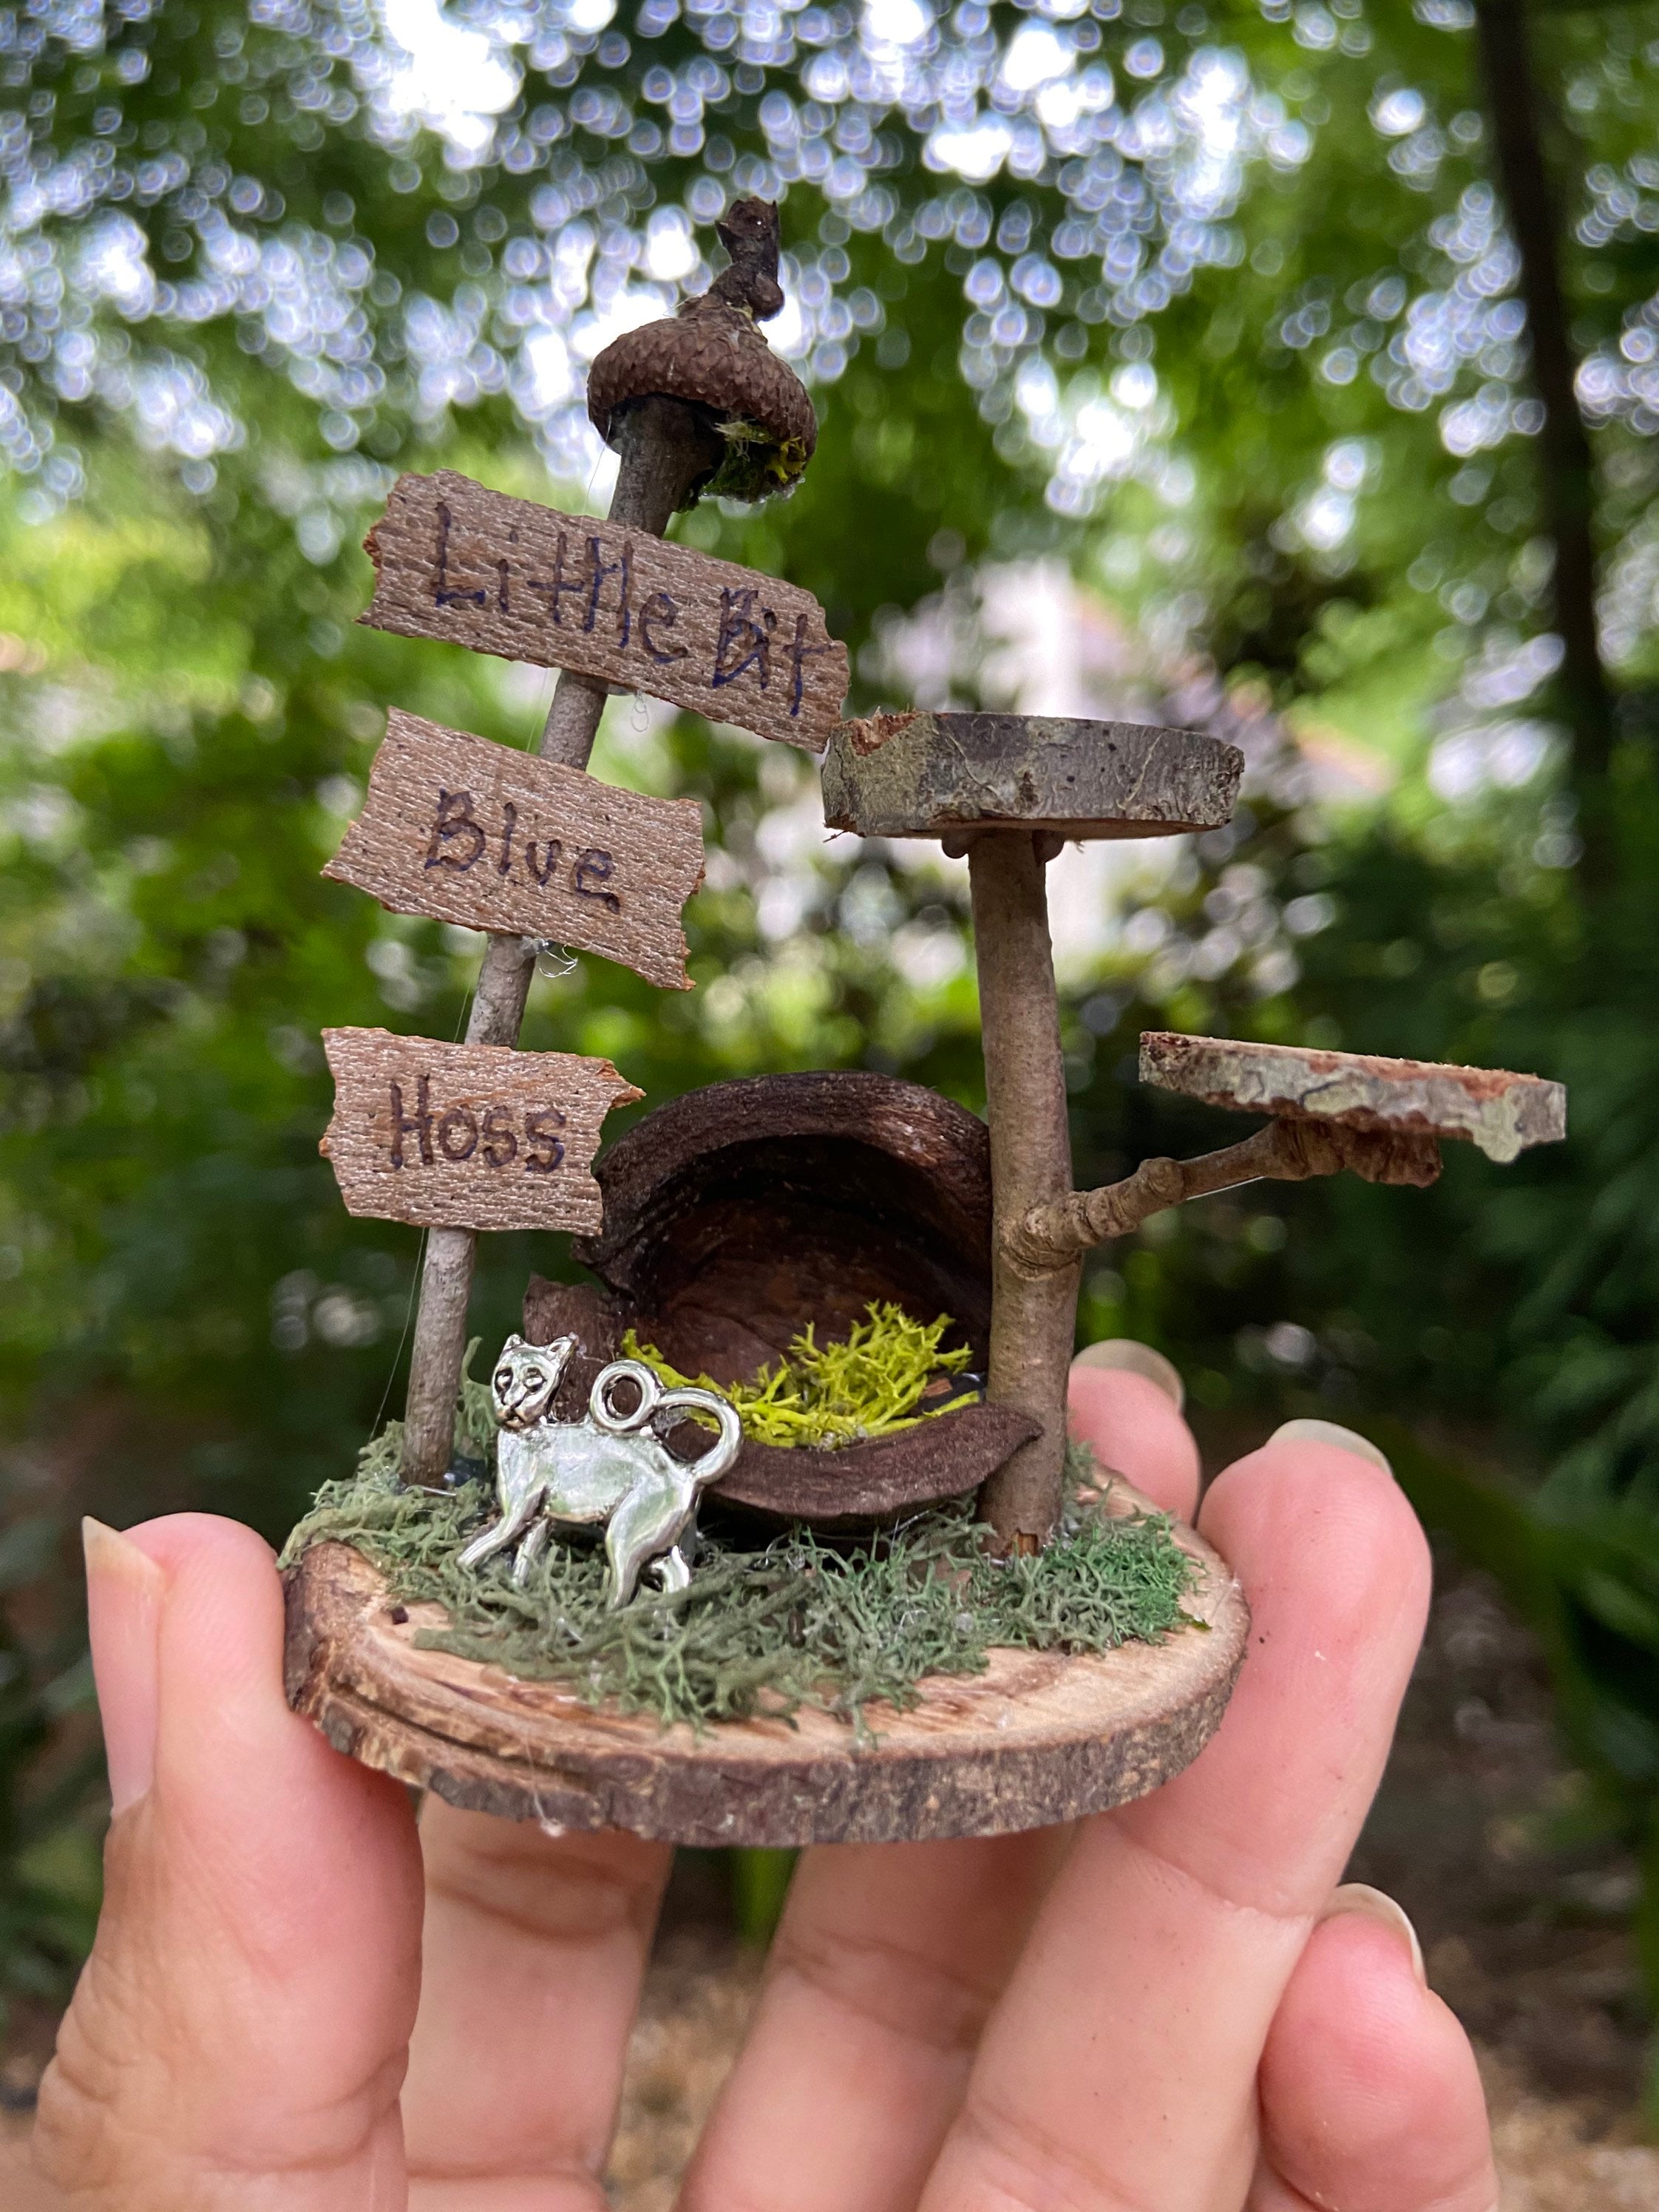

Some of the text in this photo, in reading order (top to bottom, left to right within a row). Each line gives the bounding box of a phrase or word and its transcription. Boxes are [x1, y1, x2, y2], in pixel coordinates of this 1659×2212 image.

[434, 501, 835, 716] Little Bit
[424, 788, 620, 915] Blue
[390, 1074, 566, 1173] Hoss
